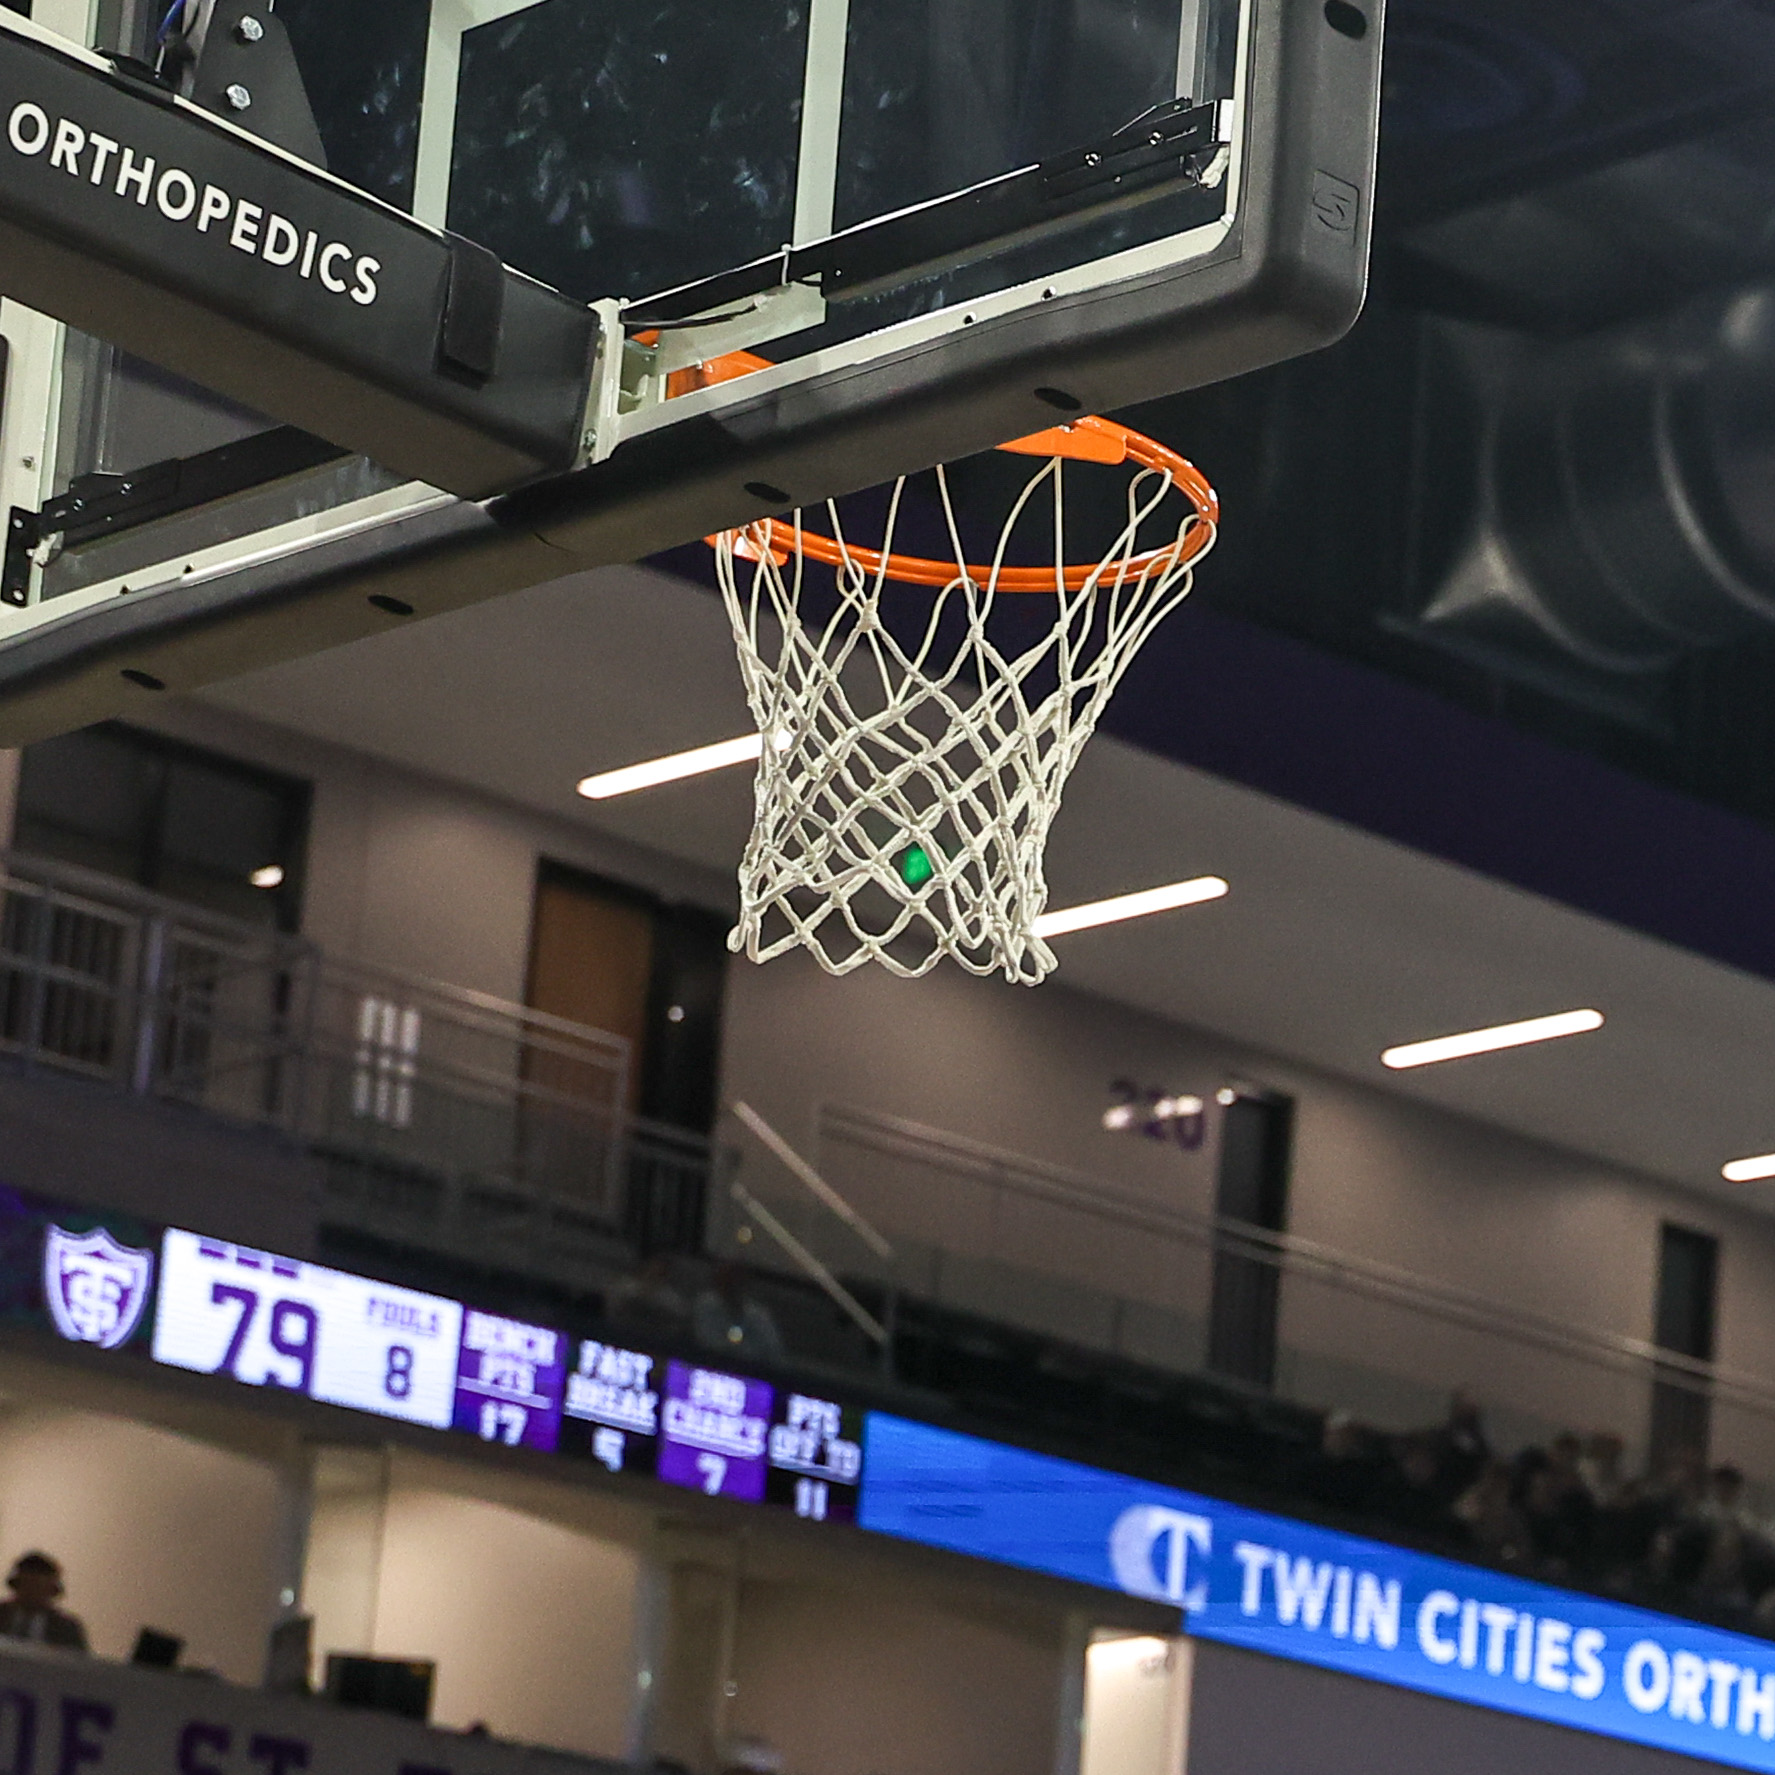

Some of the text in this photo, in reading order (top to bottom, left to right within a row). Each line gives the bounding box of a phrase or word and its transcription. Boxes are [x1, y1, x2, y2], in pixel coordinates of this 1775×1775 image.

[6, 100, 381, 306] ORTHOPEDICS
[211, 1281, 320, 1393] 79
[385, 1344, 413, 1401] 8
[480, 1400, 528, 1446] 17
[697, 1452, 727, 1496] 7
[1234, 1540, 1401, 1650] TWIN
[1416, 1589, 1607, 1700] CITIES
